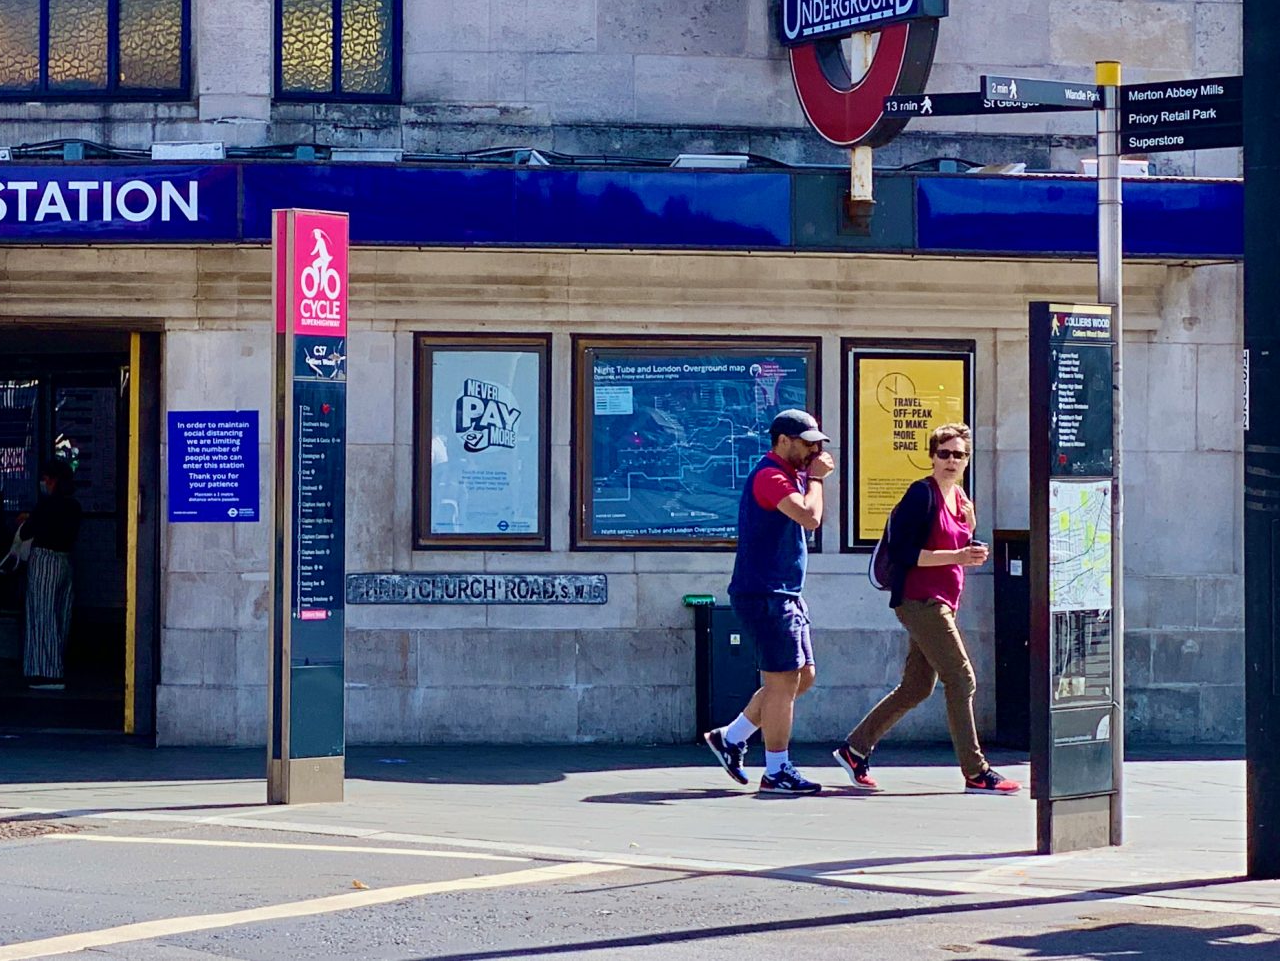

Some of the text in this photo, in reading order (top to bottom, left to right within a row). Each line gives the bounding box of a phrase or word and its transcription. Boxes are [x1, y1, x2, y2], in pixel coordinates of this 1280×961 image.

[992, 83, 1009, 94] 2 min
[1128, 84, 1224, 102] Merton Abbey Mills
[885, 100, 918, 112] 13 min
[1128, 108, 1217, 125] Priory Retail Park
[1128, 135, 1185, 149] Superstore
[300, 299, 341, 319] CYCLE
[1064, 317, 1110, 328] COLLIERS WOOD
[313, 345, 327, 356] CS7
[593, 364, 615, 375] Night
[616, 365, 635, 373] Tube
[653, 364, 681, 372] London
[682, 364, 727, 374] Overground
[729, 365, 745, 373] map
[465, 379, 499, 400] NEVER
[893, 397, 922, 407] TRAVEL
[459, 396, 522, 432] PAY
[893, 409, 933, 418] OFF-PEAK
[893, 420, 928, 429] TO MAKE
[489, 426, 516, 447] MORE
[893, 431, 915, 440] MORE
[213, 438, 241, 446] limiting
[893, 441, 918, 450] SPACE
